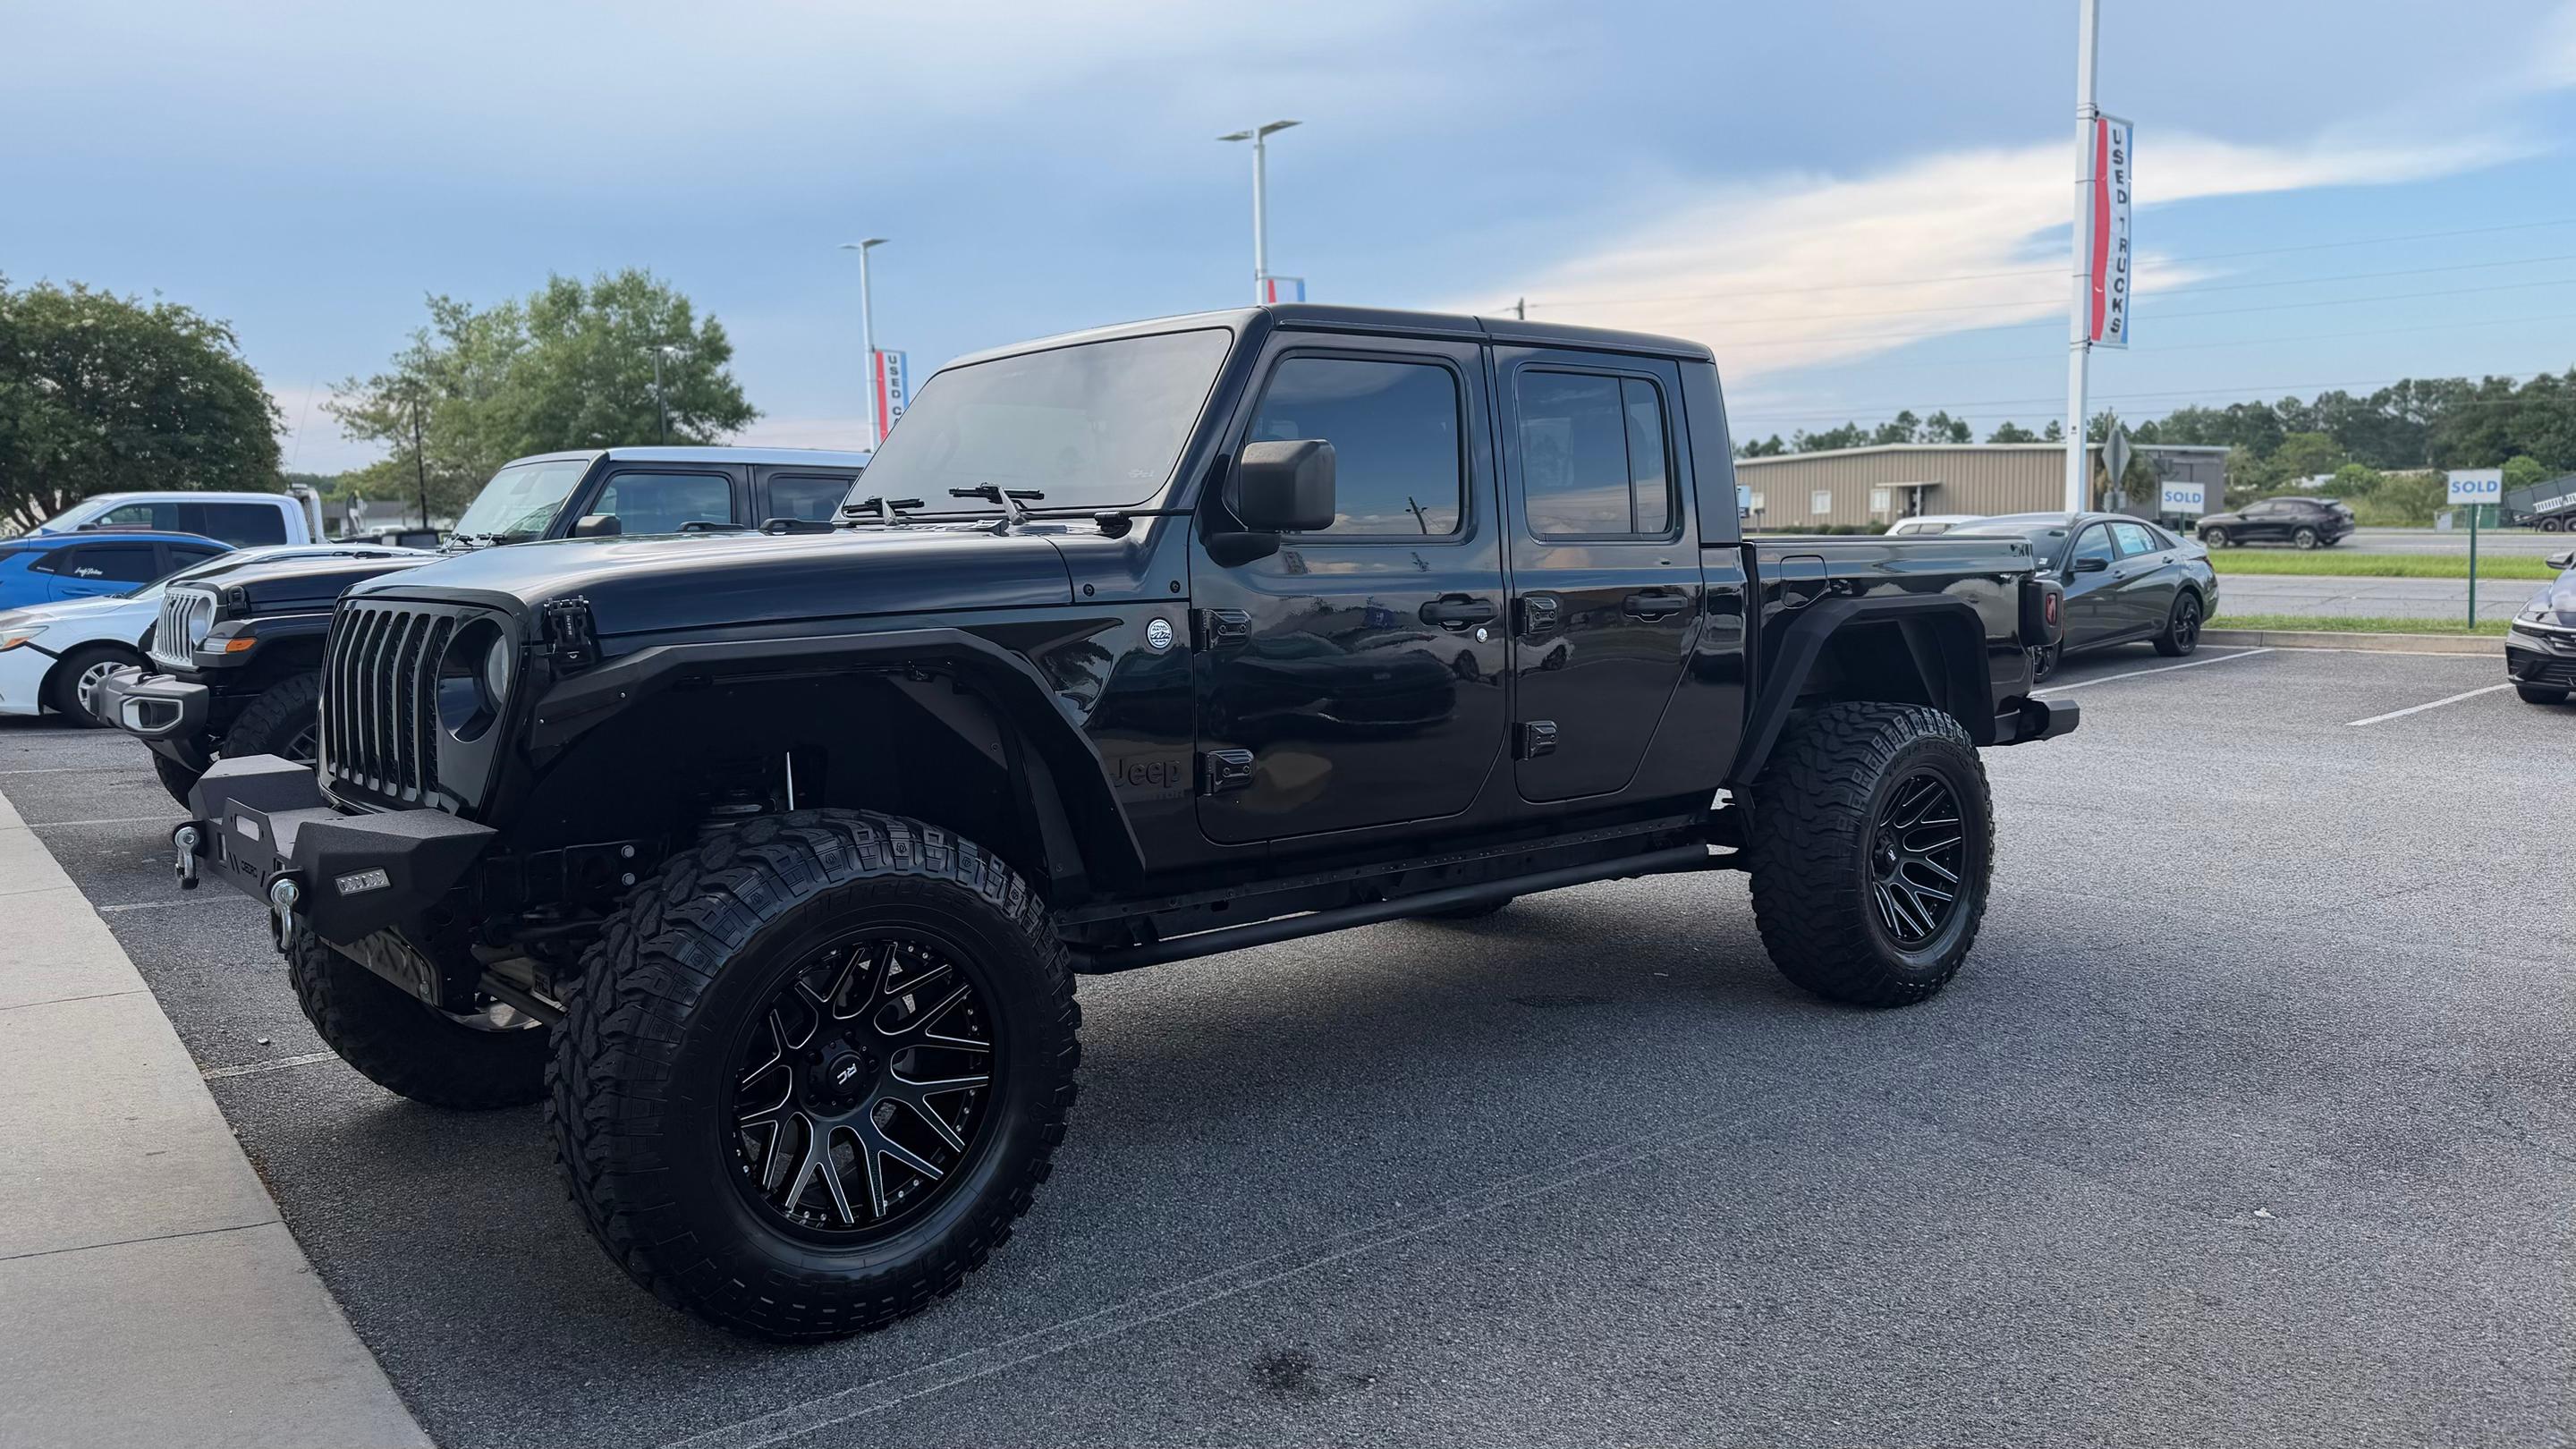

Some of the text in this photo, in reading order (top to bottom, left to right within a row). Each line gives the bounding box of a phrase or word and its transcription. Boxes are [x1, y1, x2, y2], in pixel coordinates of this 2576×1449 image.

[2112, 128, 2127, 205] USED
[888, 355, 902, 399] USED
[2165, 490, 2202, 504] SOLD
[2452, 480, 2498, 494] SOLD
[1114, 759, 1181, 789] Jeep
[837, 1063, 858, 1085] RC
